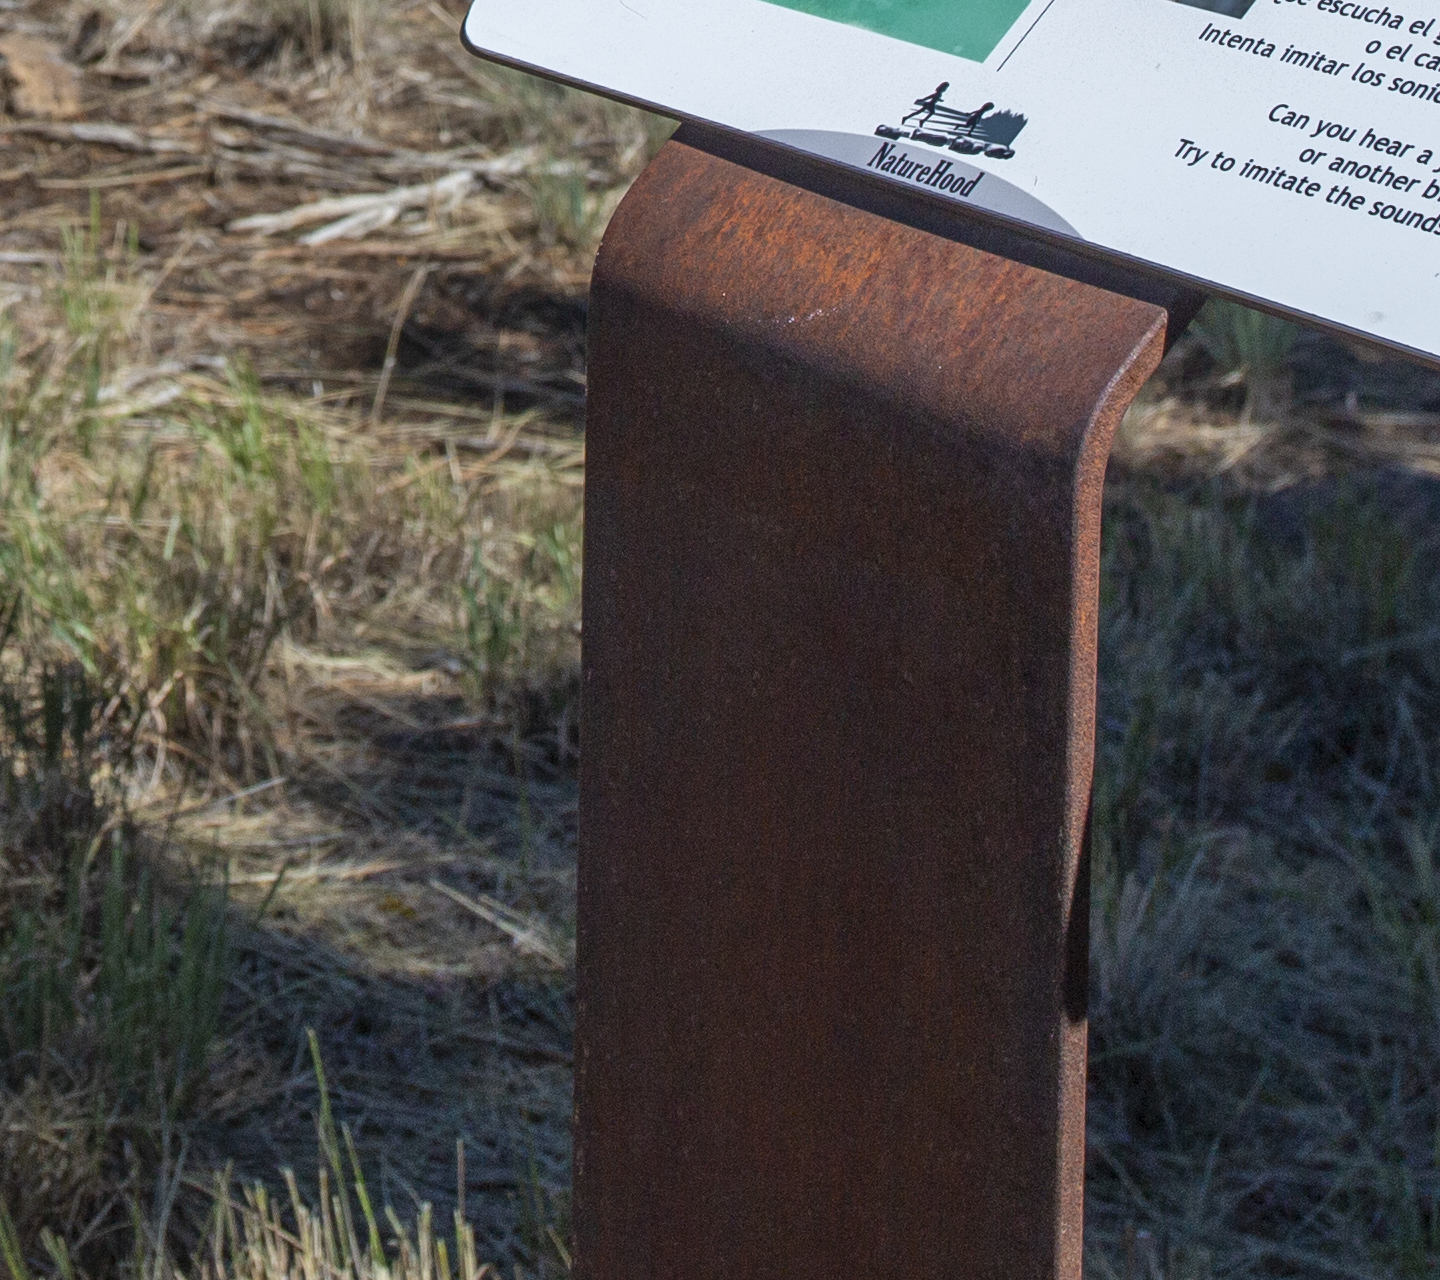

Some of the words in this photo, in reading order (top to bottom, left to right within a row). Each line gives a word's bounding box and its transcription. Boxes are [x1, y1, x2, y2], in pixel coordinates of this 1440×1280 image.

[1198, 22, 1276, 59] Intenta
[1279, 44, 1350, 76] imitar
[1351, 62, 1387, 87] los
[1365, 40, 1382, 54] o
[1385, 43, 1413, 63] el
[1408, 18, 1436, 38] el
[1268, 103, 1310, 130] Can
[1309, 119, 1358, 143] you
[1358, 127, 1416, 158] hear
[1416, 149, 1434, 166] a
[867, 142, 985, 197] NatureHood
[1174, 138, 1210, 167] Try
[1210, 151, 1236, 172] to
[1238, 158, 1322, 197] imitate
[1325, 185, 1366, 211] the
[1298, 148, 1328, 166] or
[1327, 156, 1422, 193] another
